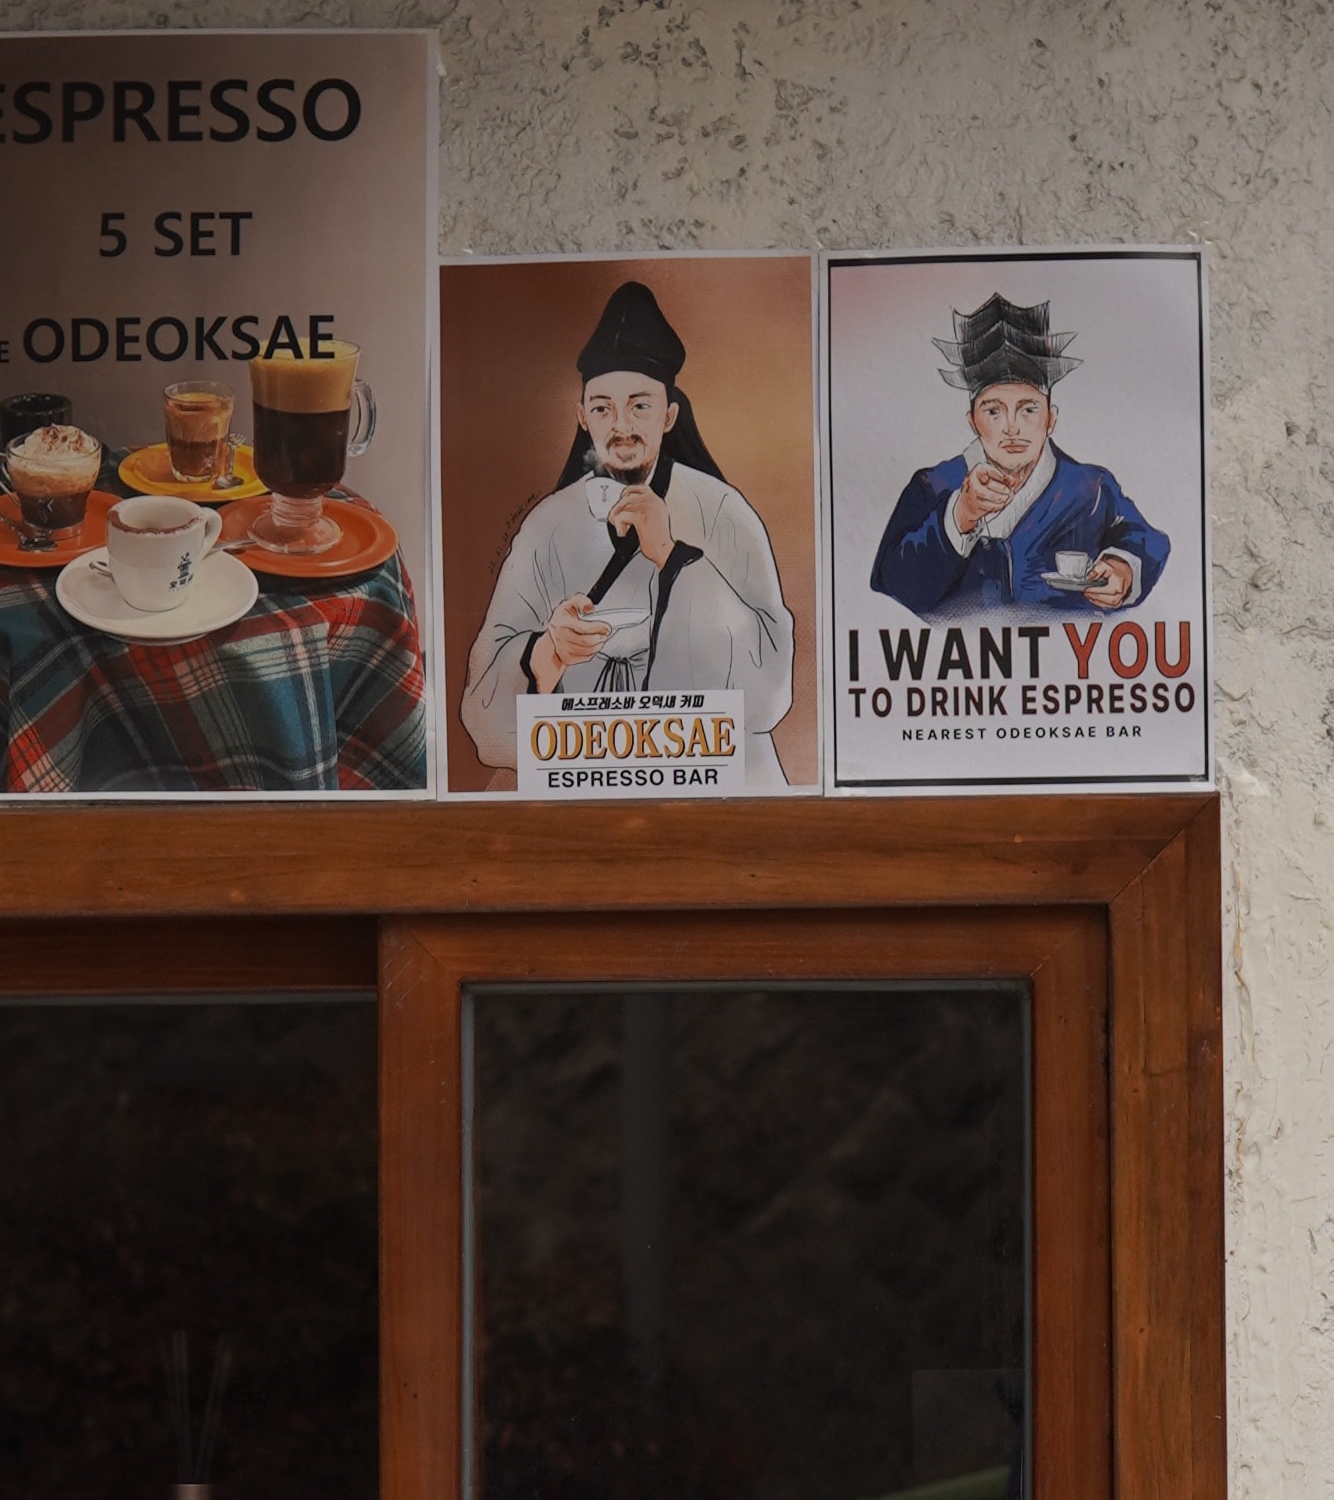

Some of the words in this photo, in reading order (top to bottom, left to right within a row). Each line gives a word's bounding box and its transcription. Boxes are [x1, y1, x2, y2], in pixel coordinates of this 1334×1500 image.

[99, 212, 127, 258] 5
[154, 211, 253, 257] SET
[22, 314, 336, 363] ODEOKSAE
[848, 628, 859, 682] I
[878, 626, 1051, 681] WANT
[1062, 620, 1192, 680] YOU
[848, 685, 893, 718] TO
[906, 684, 1008, 718] DRINK
[1021, 681, 1196, 716] ESPRESSO
[530, 716, 736, 761] ODEOKSAE
[902, 728, 987, 742] NEAREST
[995, 725, 1098, 740] ODEOKSAE
[1106, 723, 1142, 738] BAR
[548, 769, 664, 788] ESPRESSO
[673, 768, 718, 785] BAR
